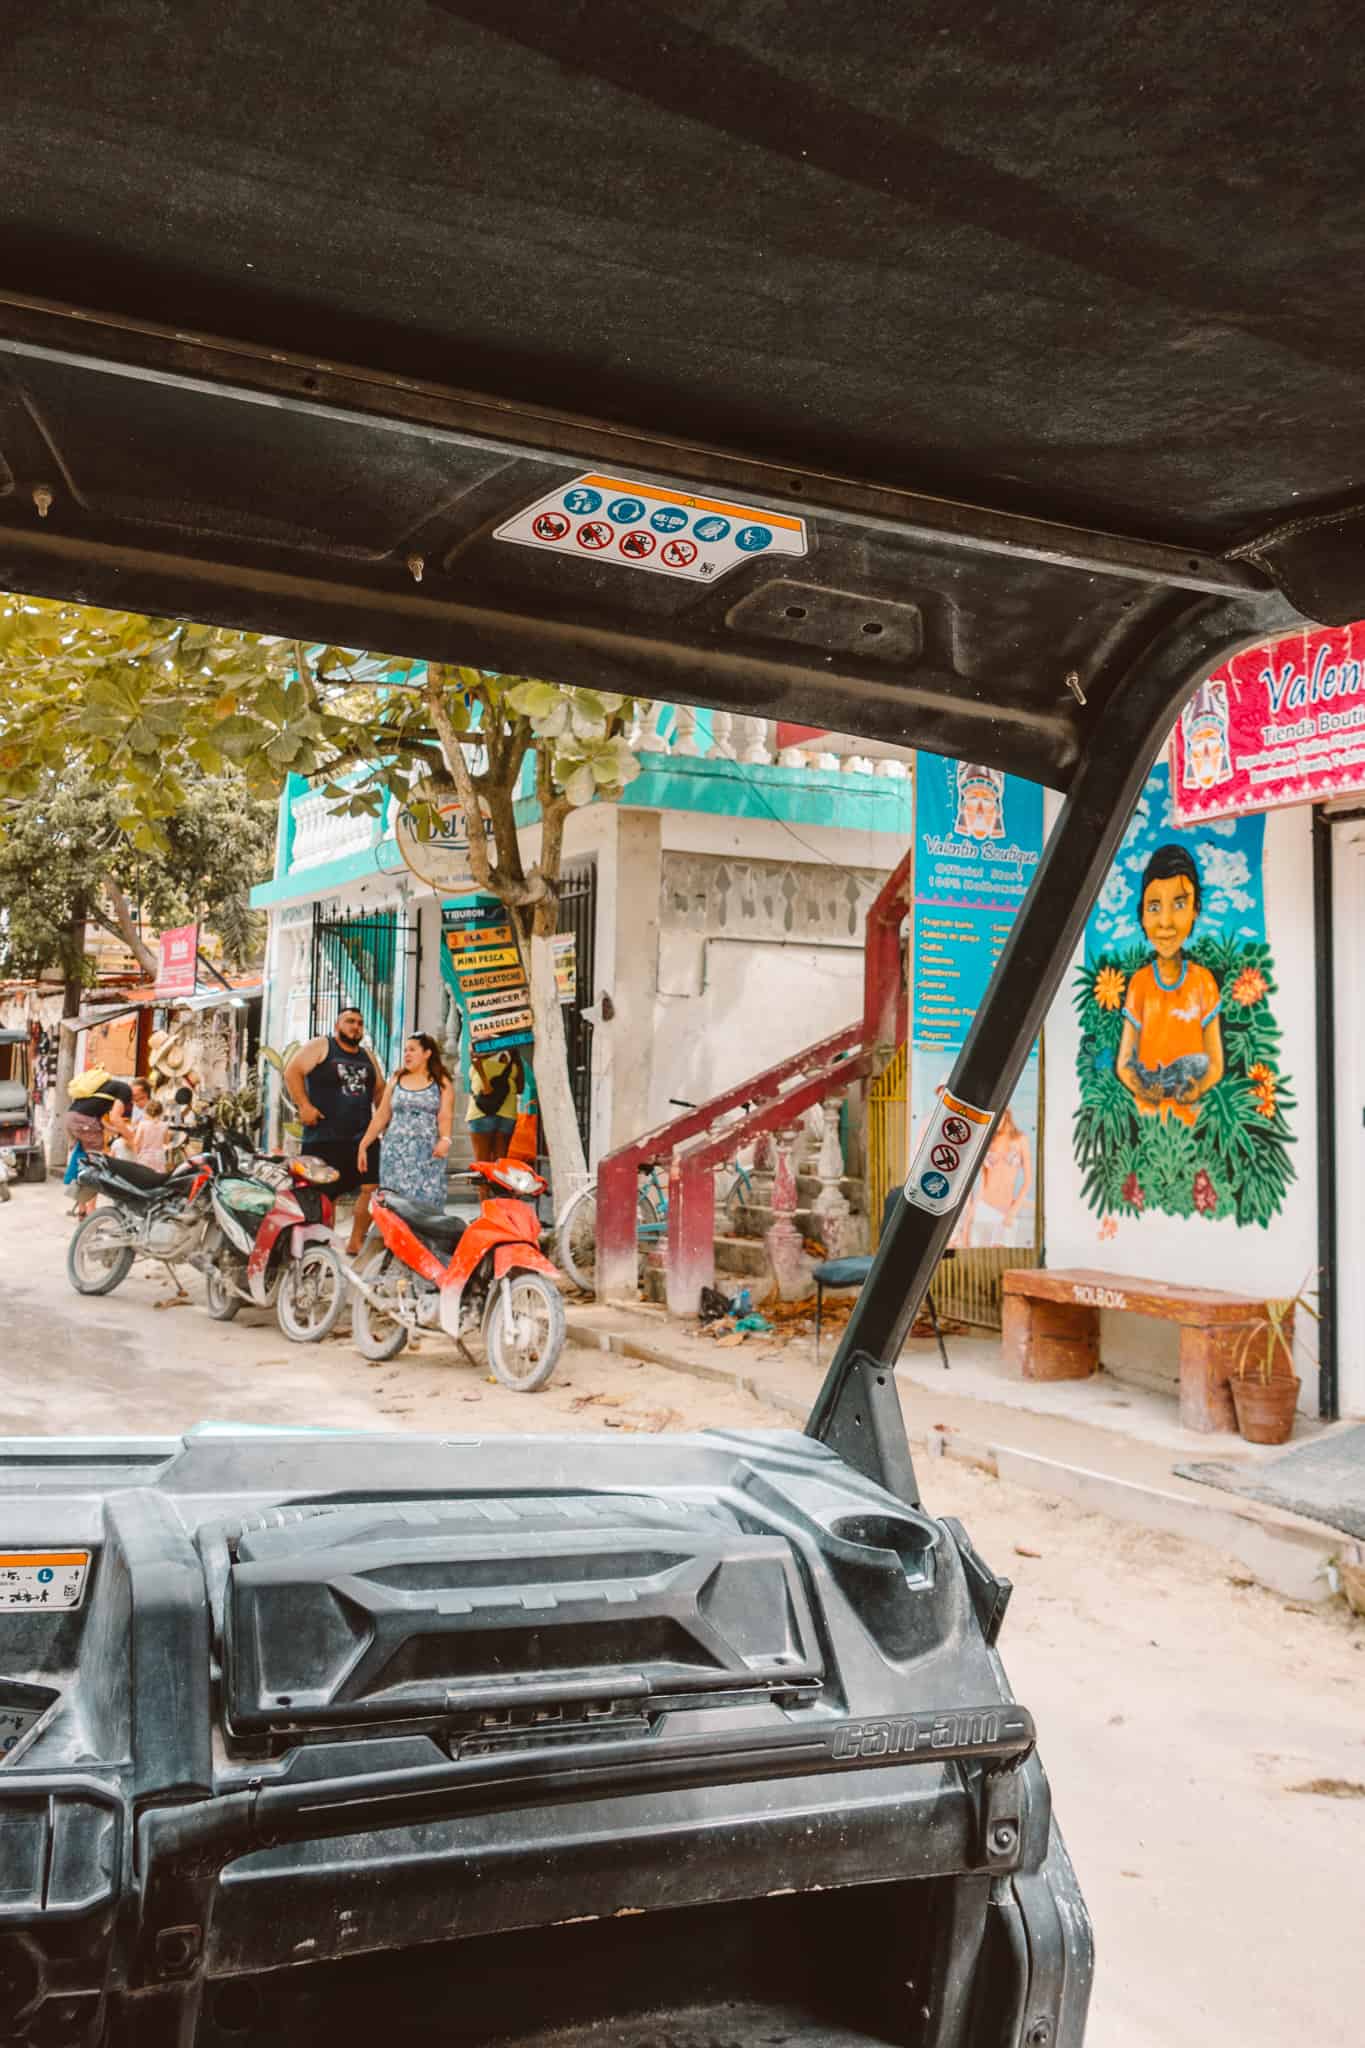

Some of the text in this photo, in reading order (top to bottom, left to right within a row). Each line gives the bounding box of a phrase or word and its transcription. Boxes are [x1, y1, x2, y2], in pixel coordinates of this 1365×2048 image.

[1260, 645, 1365, 710] Valen
[1262, 706, 1365, 745] Tienda Bouti
[923, 833, 978, 858] Valentin
[478, 952, 505, 964] PESCA
[470, 993, 520, 1009] AMANECER
[473, 1017, 520, 1033] ATARDECER
